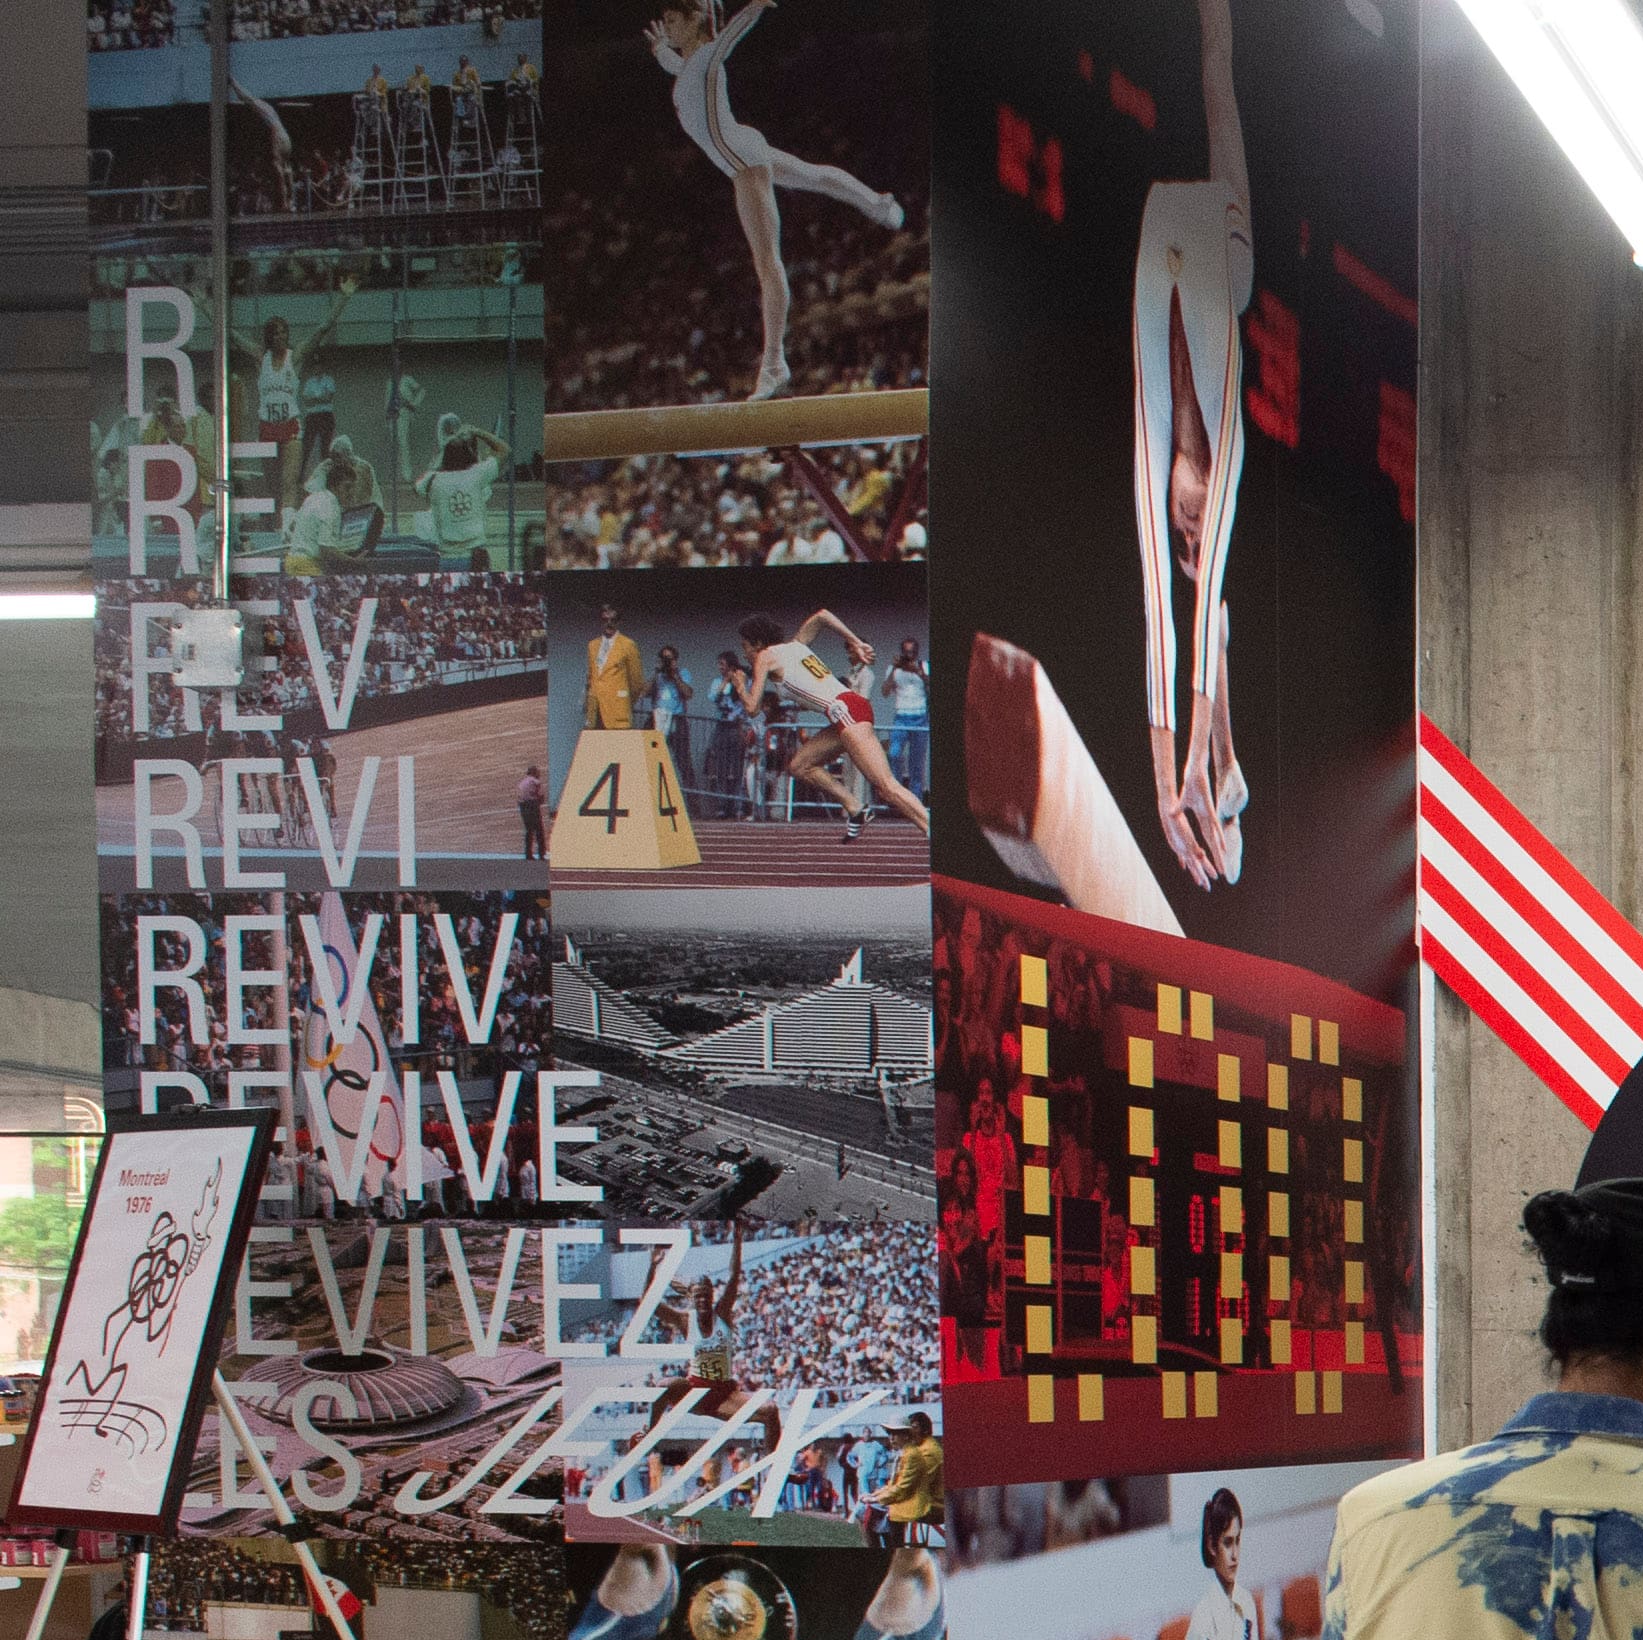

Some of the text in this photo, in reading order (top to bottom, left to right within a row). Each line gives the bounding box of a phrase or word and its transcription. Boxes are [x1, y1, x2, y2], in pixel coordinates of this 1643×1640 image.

[126, 286, 197, 417] R
[128, 442, 281, 577] RE
[130, 599, 379, 734] REV
[133, 755, 418, 890] REVI
[578, 762, 630, 835] 4
[658, 761, 679, 833] 4
[135, 913, 520, 1046] REVIV
[126, 1196, 153, 1213] 1976
[235, 1226, 694, 1362] EVIVEZ
[397, 1386, 895, 1518] JEUX
